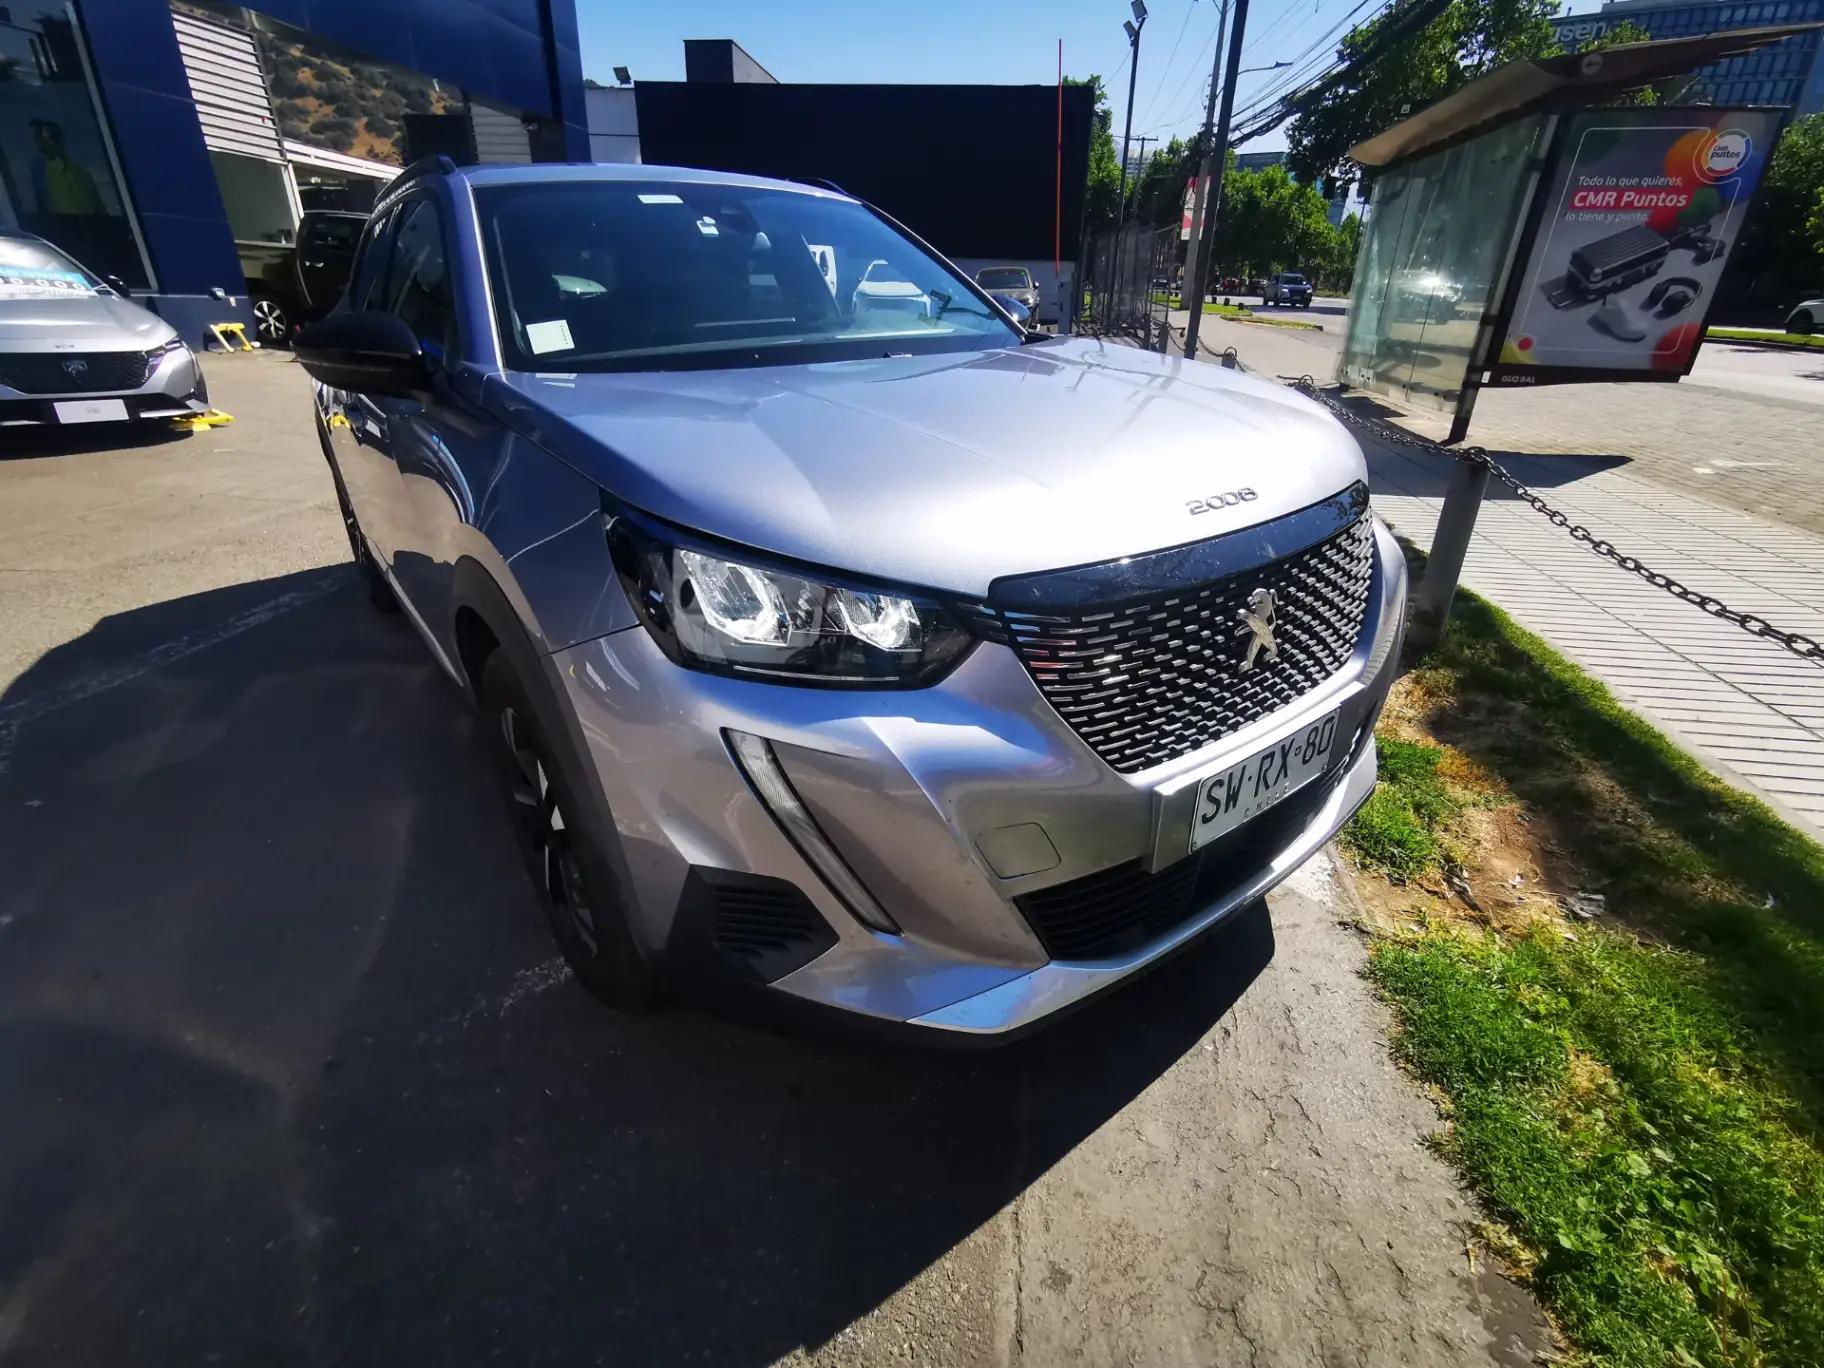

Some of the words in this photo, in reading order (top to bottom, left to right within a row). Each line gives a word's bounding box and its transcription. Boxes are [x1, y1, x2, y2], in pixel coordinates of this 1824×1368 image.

[1578, 176, 1603, 186] Todo
[1605, 175, 1616, 186] lo
[1618, 178, 1639, 187] que
[1574, 191, 1618, 207] CMR
[1620, 191, 1688, 207] Puntos
[1566, 212, 1577, 221] lo
[1579, 211, 1603, 221] tiene
[1606, 213, 1614, 223] y
[1186, 487, 1259, 515] 2008
